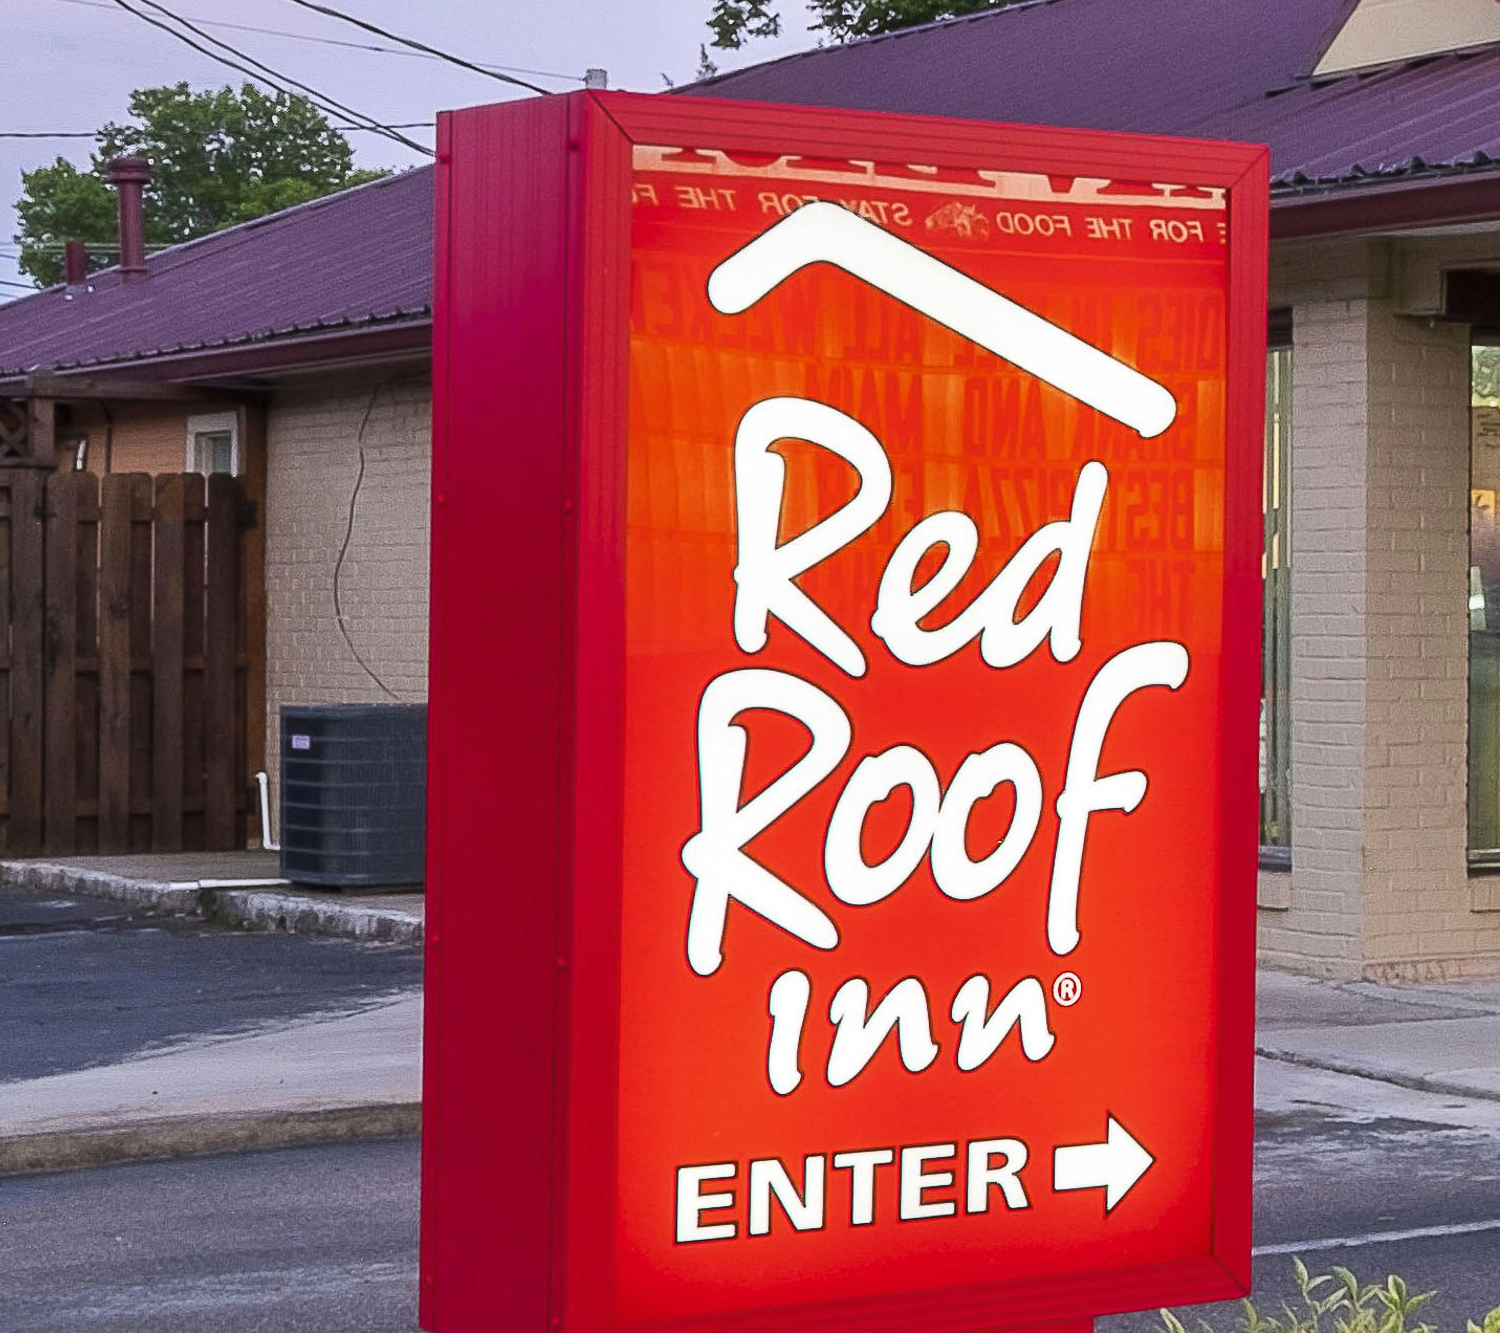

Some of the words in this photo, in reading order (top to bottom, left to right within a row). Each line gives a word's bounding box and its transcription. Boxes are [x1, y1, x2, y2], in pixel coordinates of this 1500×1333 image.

[731, 395, 1110, 679] Red
[679, 639, 1190, 978] Roof
[675, 1138, 1030, 1244] ENTER
